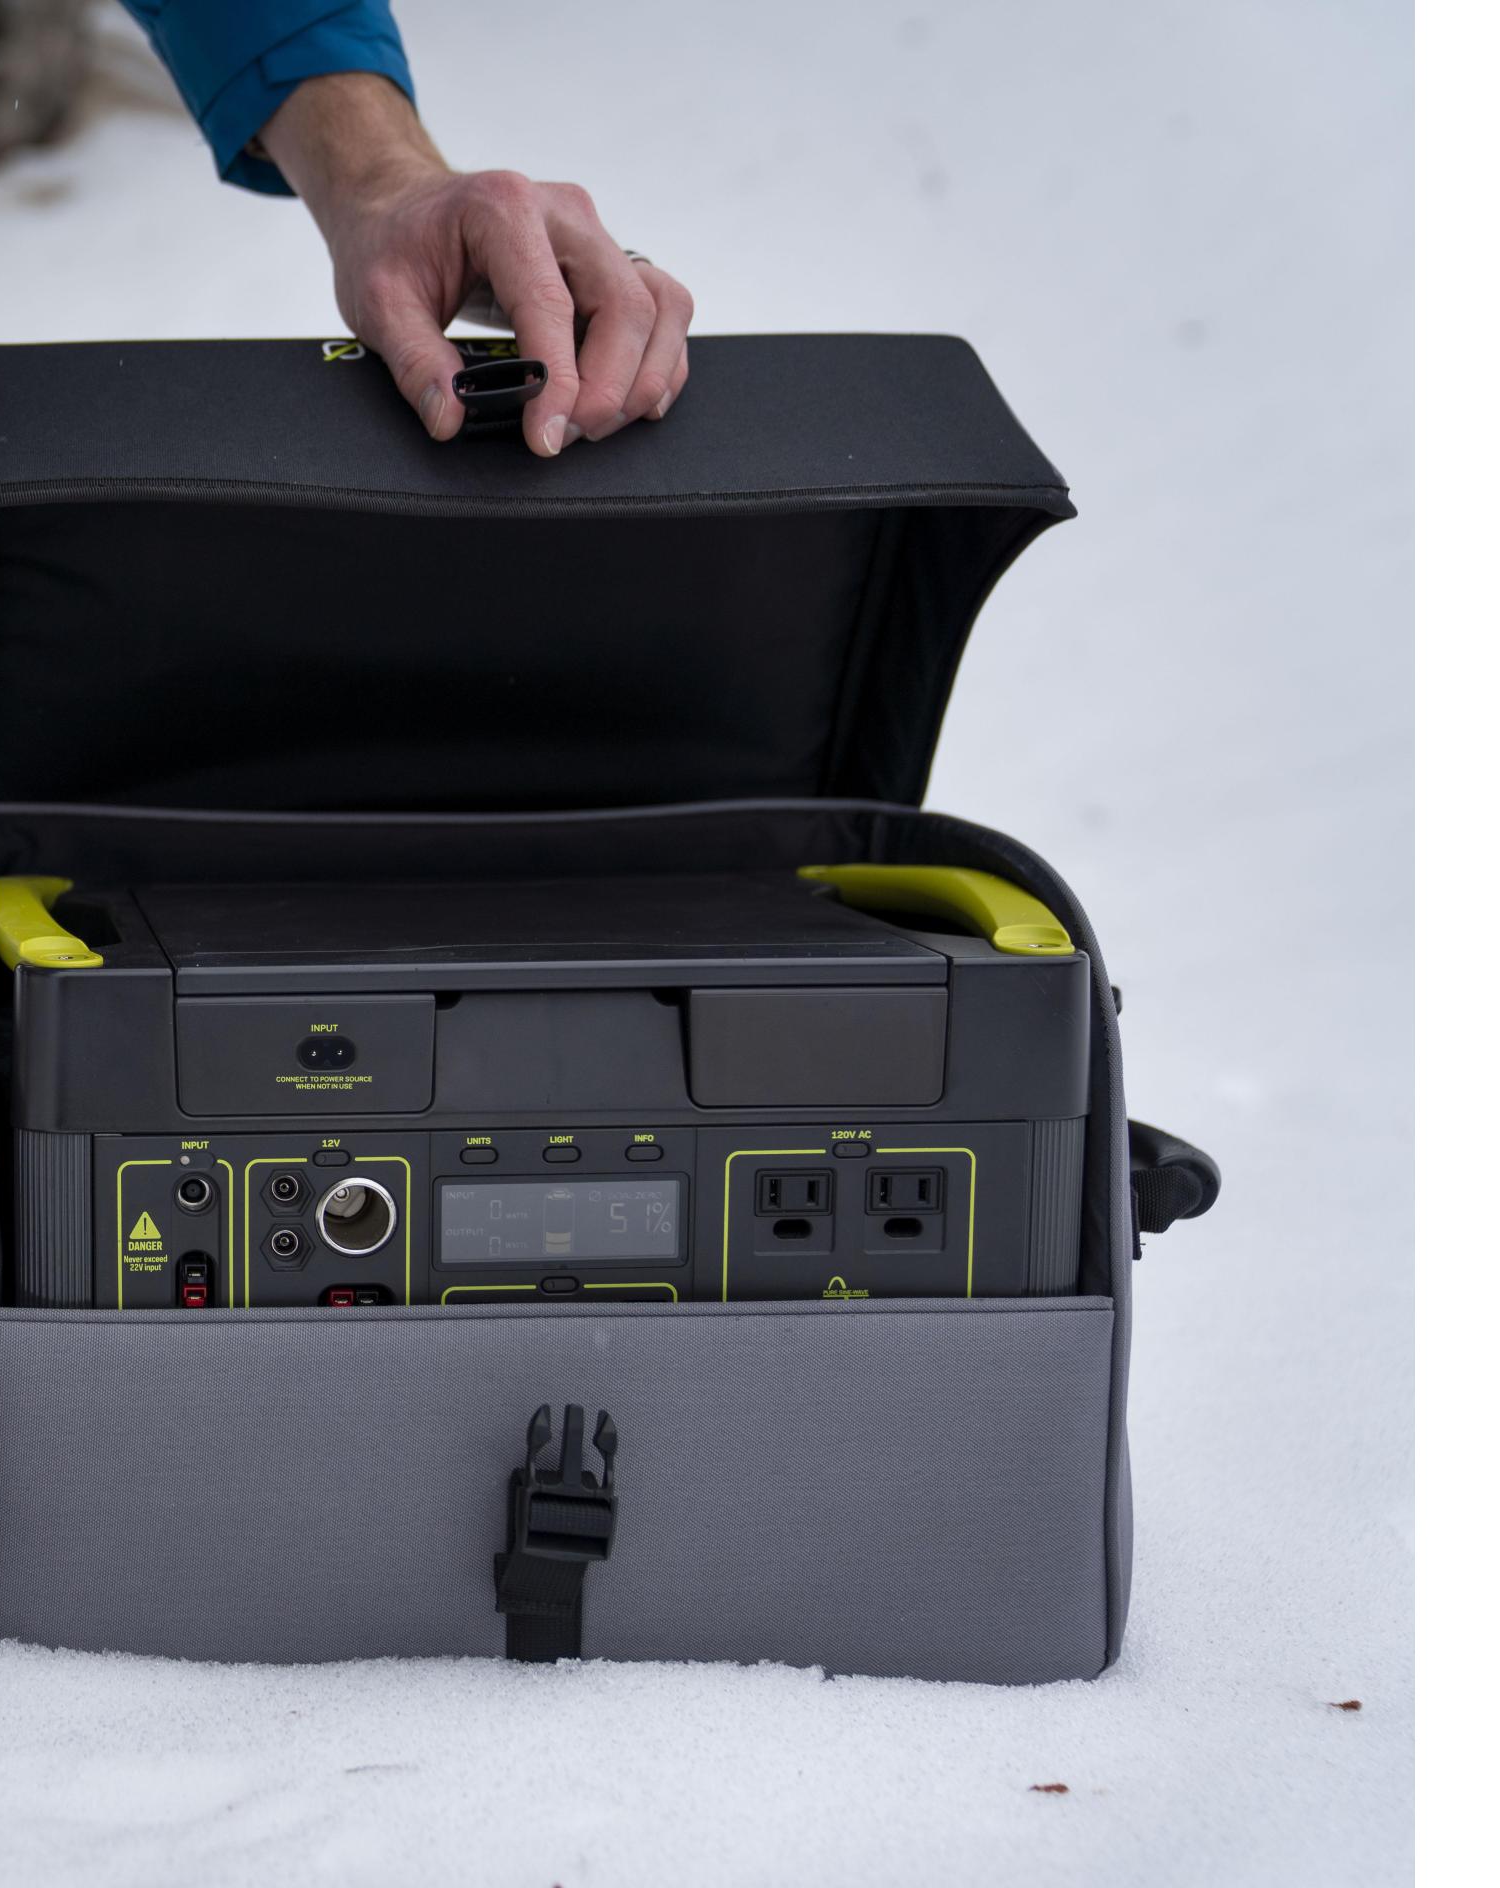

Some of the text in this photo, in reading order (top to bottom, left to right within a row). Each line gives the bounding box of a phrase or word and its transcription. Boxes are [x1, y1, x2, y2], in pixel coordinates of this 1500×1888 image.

[310, 1023, 338, 1032] INPUT
[634, 1134, 654, 1142] INFO
[831, 1130, 872, 1139] 120V AC
[321, 1139, 341, 1148] 12V
[466, 1137, 492, 1145] UNITS
[549, 1135, 574, 1144] LIGHT
[181, 1140, 209, 1149] INPUT
[445, 1191, 475, 1200] INPUT
[445, 1227, 484, 1236] OUTPUT
[127, 1241, 163, 1251] DANGER
[123, 1254, 168, 1263] Never exceed
[129, 1263, 162, 1272] 22V input
